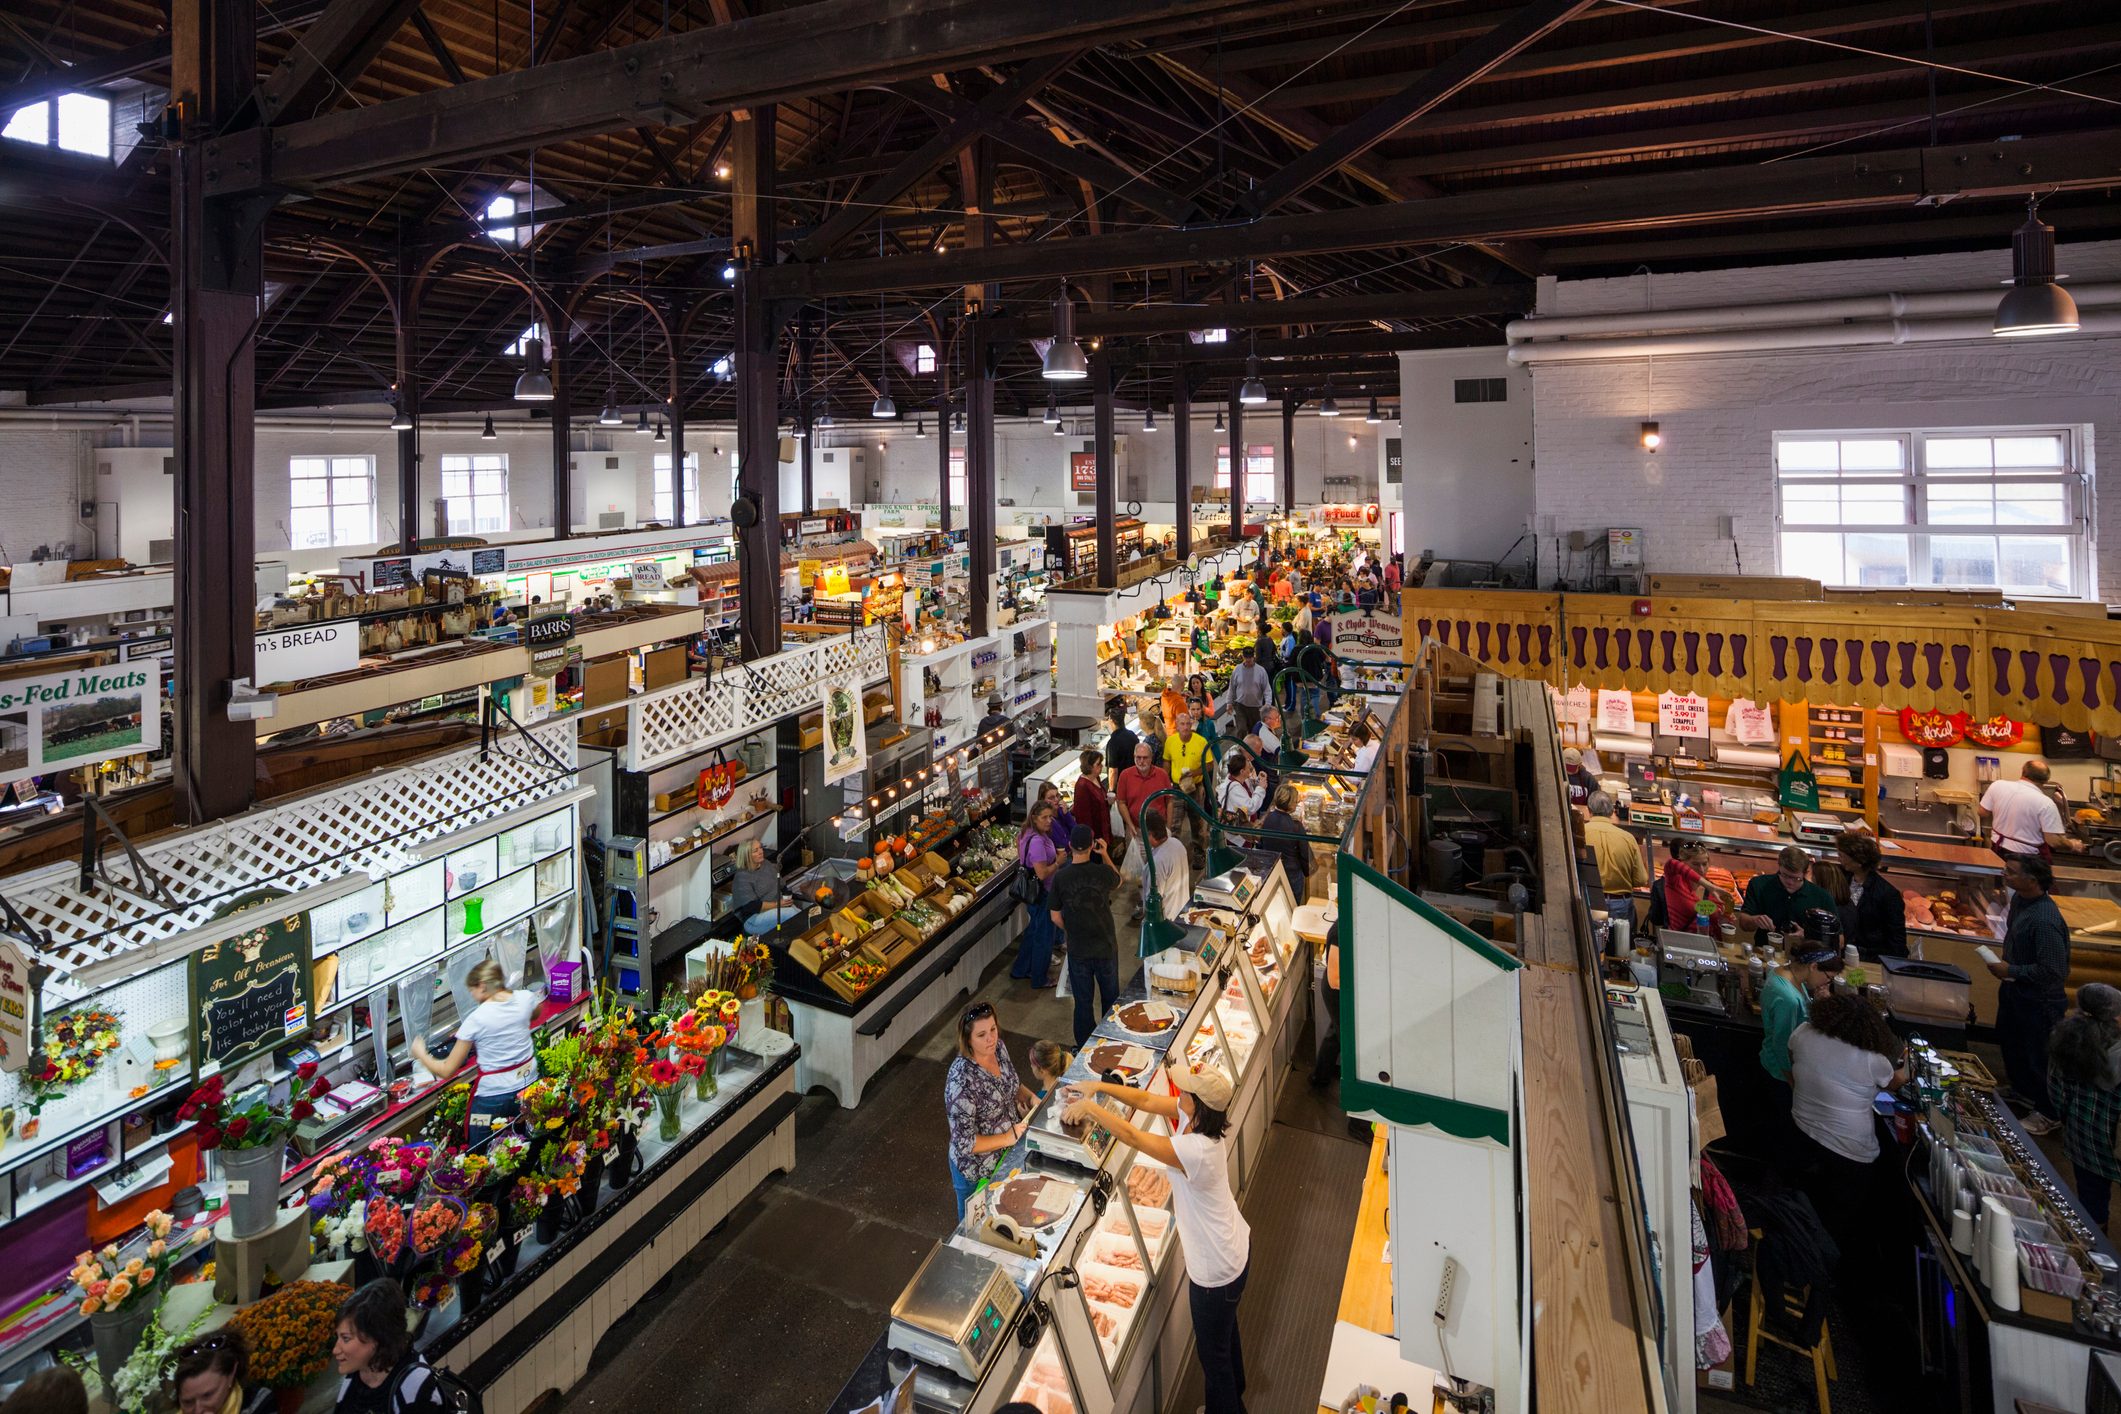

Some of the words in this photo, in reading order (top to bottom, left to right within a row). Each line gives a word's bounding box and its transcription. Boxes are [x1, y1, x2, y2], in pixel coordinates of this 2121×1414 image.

[1074, 465, 1096, 475] 173
[1390, 457, 1401, 466] SEE
[508, 560, 523, 570] SOUPS
[526, 559, 542, 567] SALADS
[1345, 618, 1367, 632] Clyde
[1369, 618, 1400, 635] Weaver
[282, 628, 337, 649] BREAD
[1338, 634, 1359, 642] SMOKED
[1360, 636, 1376, 645] MEATS
[1380, 639, 1400, 647] CHEESE
[534, 647, 565, 661] PRODUCE
[75, 671, 147, 697] Meats
[1911, 713, 1943, 726] love
[1924, 720, 1953, 739] local
[1981, 720, 2012, 738] local
[705, 773, 726, 791] love
[712, 775, 732, 800] local
[878, 806, 898, 822] PEPPERS
[846, 821, 870, 840] CUCUMBERS
[209, 978, 228, 992] For
[234, 967, 249, 982] All
[255, 952, 294, 974] Occasions
[257, 983, 283, 1004] need
[0, 997, 24, 1020] ERS
[216, 1017, 244, 1035] color
[250, 1011, 259, 1019] in
[264, 999, 288, 1016] your
[289, 1020, 303, 1030] VISA
[217, 1036, 232, 1051] life
